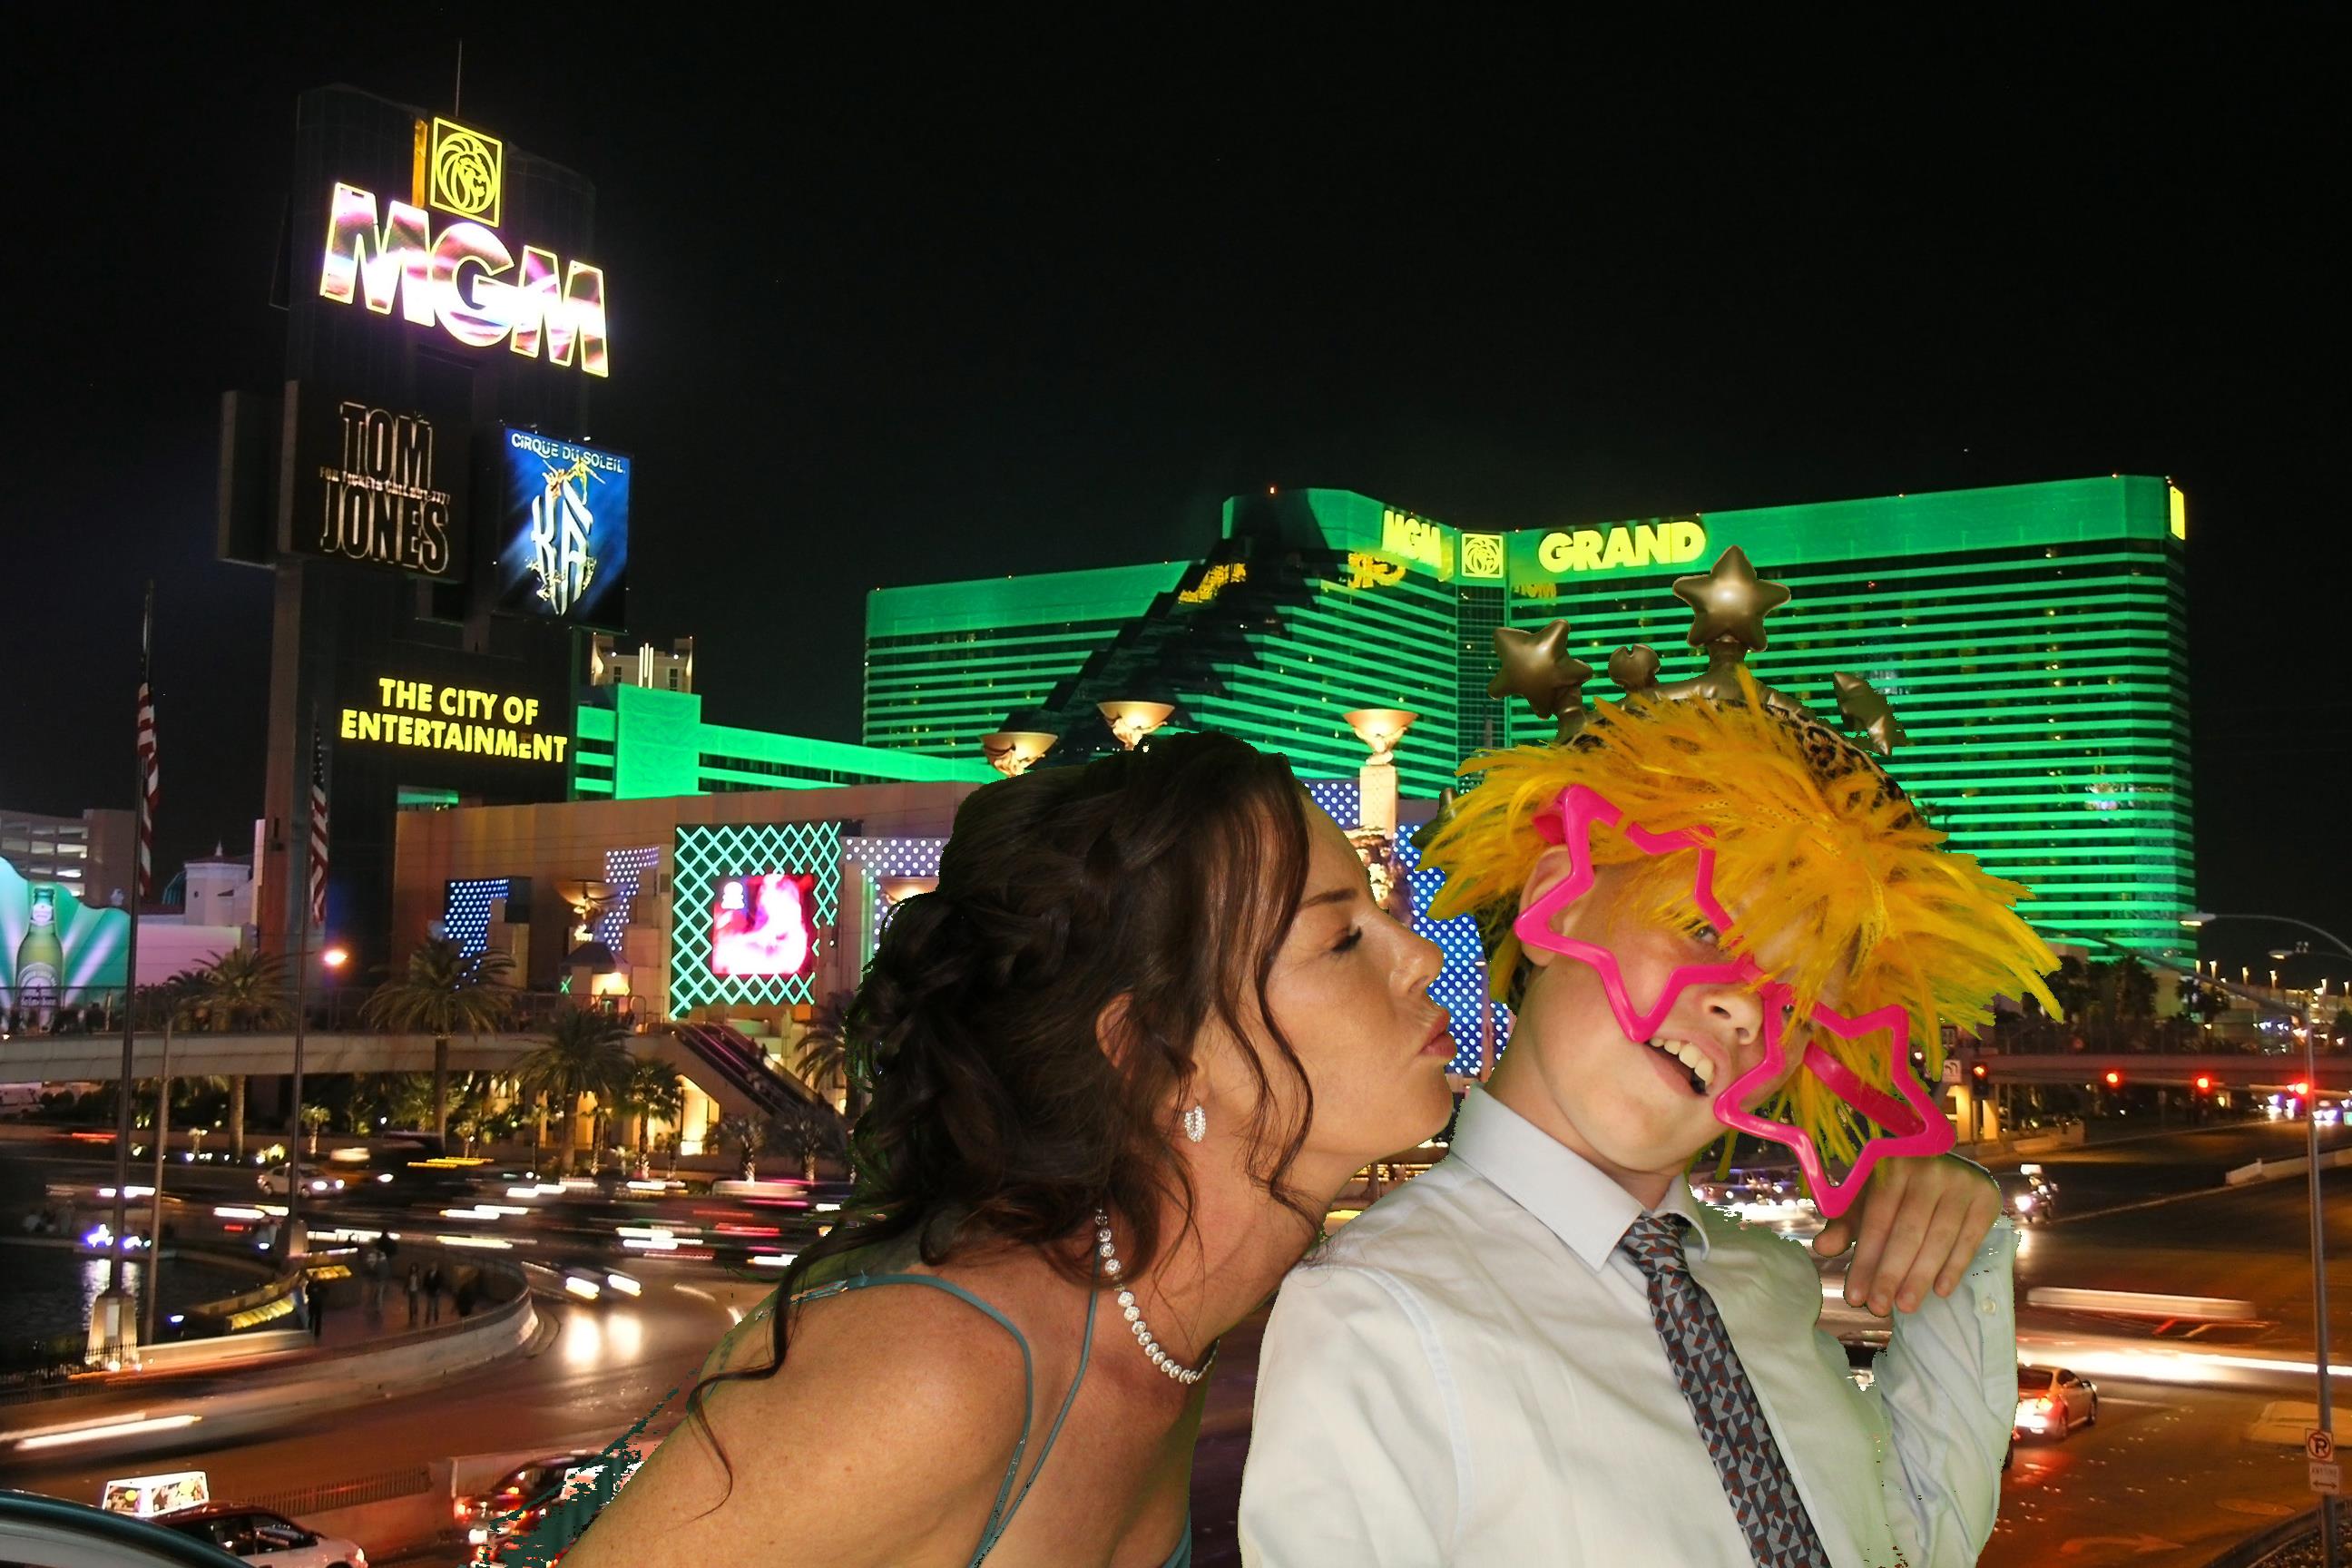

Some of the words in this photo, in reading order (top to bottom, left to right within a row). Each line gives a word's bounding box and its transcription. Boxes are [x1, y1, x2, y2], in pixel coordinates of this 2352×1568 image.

[320, 182, 609, 377] MGM
[339, 401, 433, 490] TOM
[511, 433, 559, 459] CIRQUE
[563, 446, 580, 462] DU
[582, 451, 624, 474] SOLEIL
[320, 484, 449, 573] JONES
[1382, 510, 1442, 569] MGM
[1538, 521, 1707, 573] GRAND
[379, 678, 434, 712] THE
[439, 687, 498, 720] CITY
[503, 696, 539, 725] OF
[341, 709, 568, 763] ENTERTAINMENT
